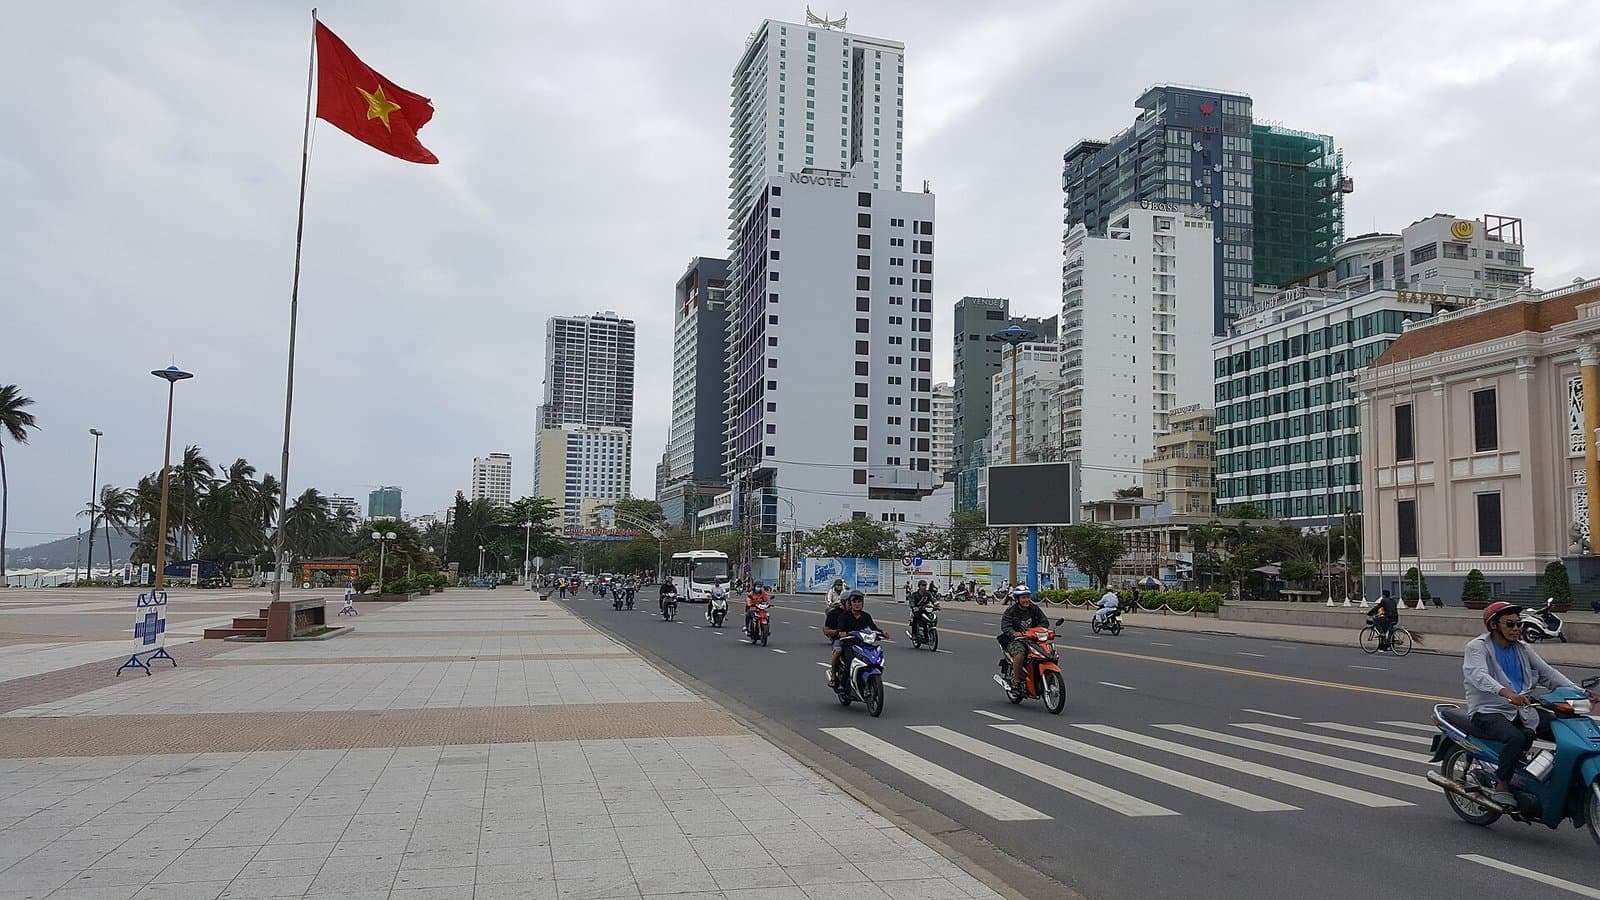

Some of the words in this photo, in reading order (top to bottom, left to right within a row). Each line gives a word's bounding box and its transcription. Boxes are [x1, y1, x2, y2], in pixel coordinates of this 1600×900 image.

[790, 172, 849, 188] NOVOTEL
[1151, 202, 1179, 212] BOSS
[971, 298, 1000, 306] VENUE
[1397, 290, 1448, 304] HAPPY
